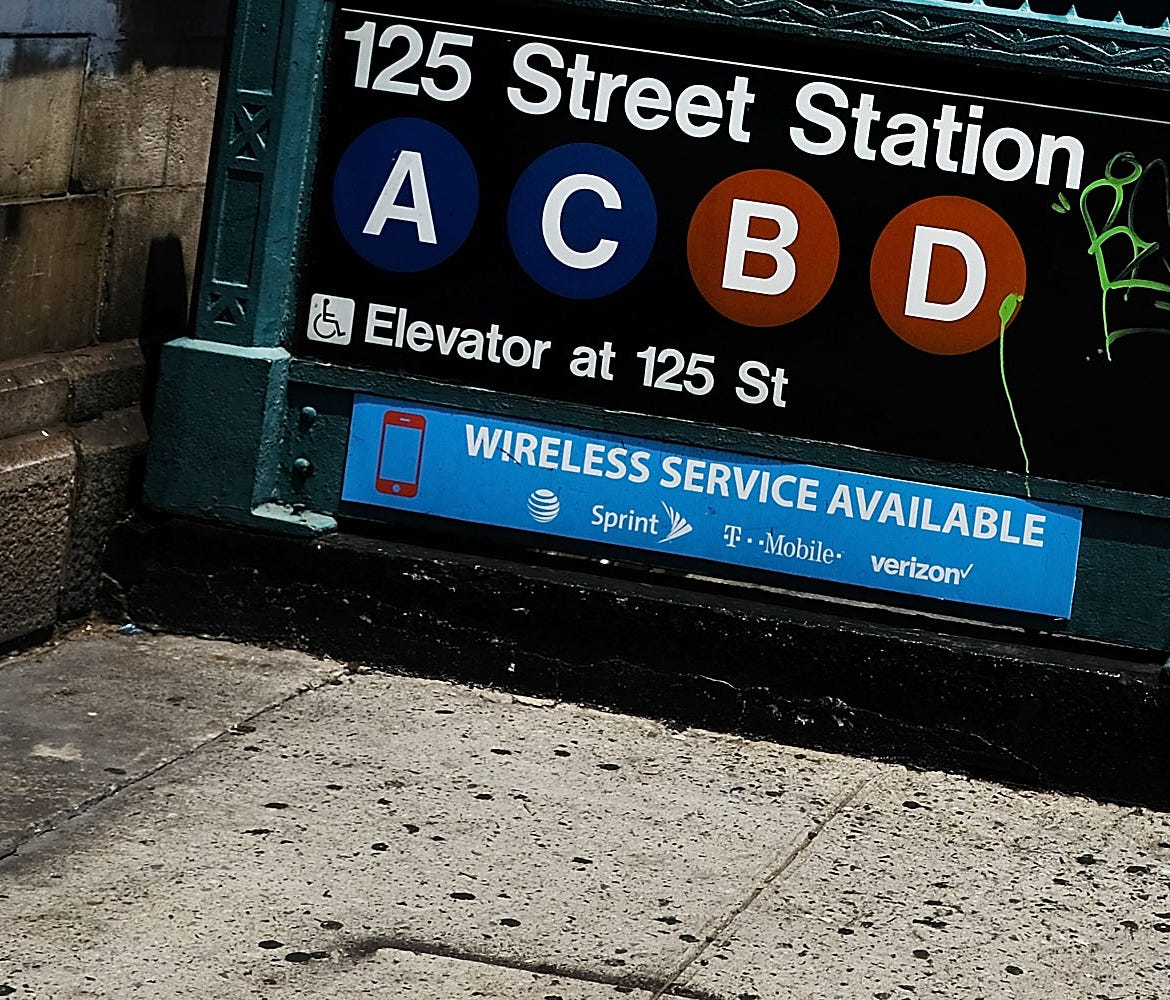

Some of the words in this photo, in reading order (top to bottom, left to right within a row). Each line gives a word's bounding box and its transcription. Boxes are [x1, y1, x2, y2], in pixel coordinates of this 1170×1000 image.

[344, 20, 474, 102] 125
[506, 42, 756, 144] Street
[789, 81, 1085, 190] Station
[362, 149, 438, 245] A
[541, 173, 622, 270] C
[721, 198, 799, 296] B
[904, 225, 987, 322] D
[364, 302, 552, 370] Elevator
[569, 341, 617, 381] at
[636, 345, 715, 396] 125
[735, 360, 789, 408] St
[465, 423, 651, 483] WIRELESS
[659, 455, 820, 512] SERVICE
[826, 484, 1047, 548] AVAILABLE
[591, 503, 659, 537] Sprint
[870, 555, 962, 585] verizon
